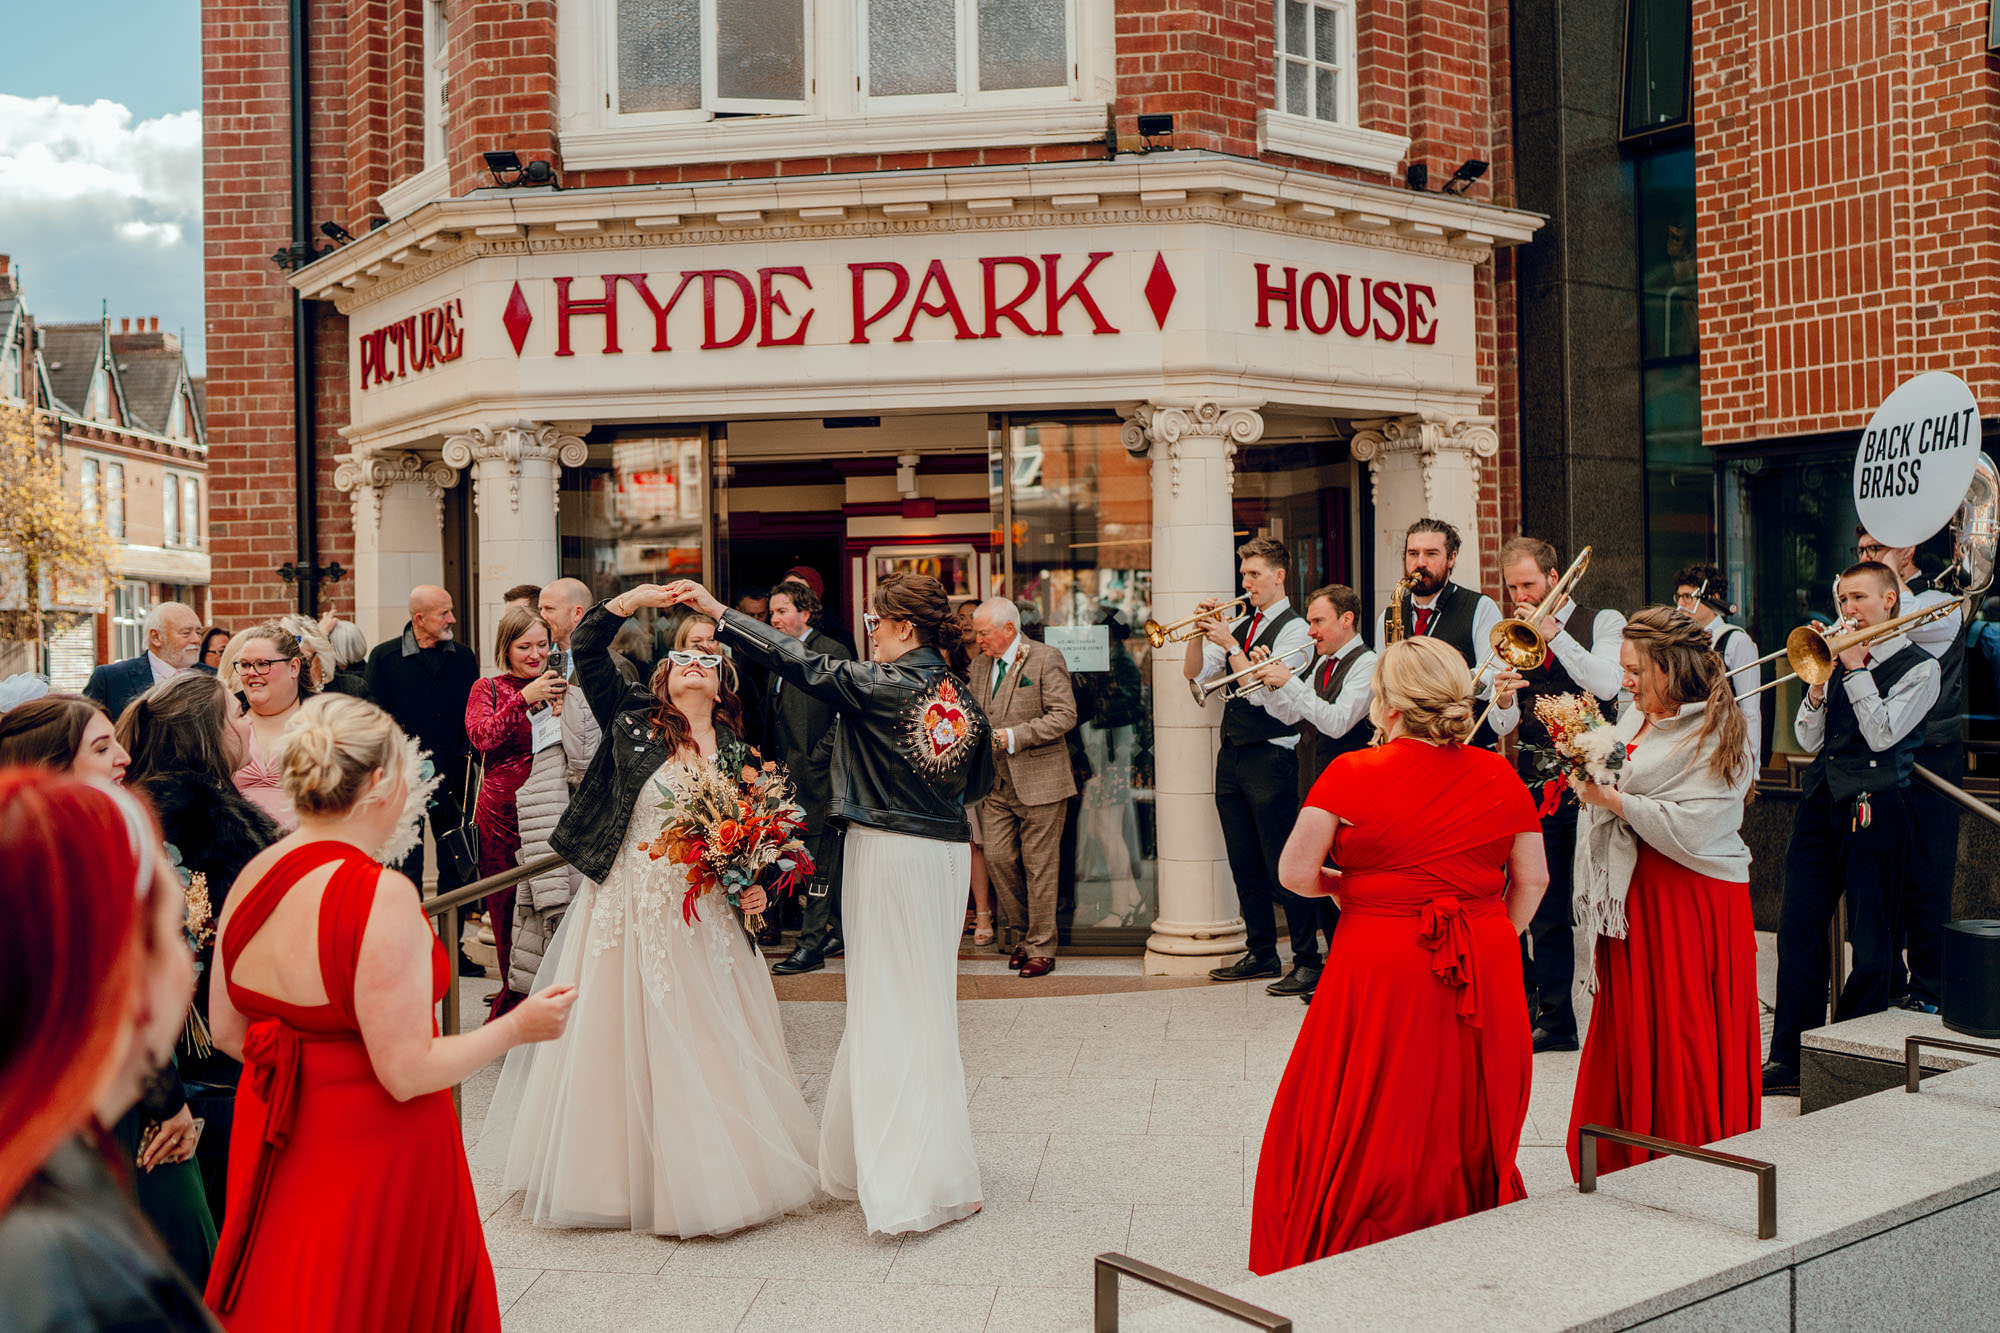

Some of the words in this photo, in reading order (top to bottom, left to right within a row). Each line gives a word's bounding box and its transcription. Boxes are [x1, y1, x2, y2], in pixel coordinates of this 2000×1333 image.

[360, 298, 464, 391] PICTURE
[552, 265, 816, 357] HYDE
[848, 250, 1121, 344] PARK
[1253, 262, 1439, 345] HOUSE
[1864, 421, 1915, 463] BACK
[1918, 407, 1975, 454] CHAT
[1859, 458, 1922, 500] BRASS
